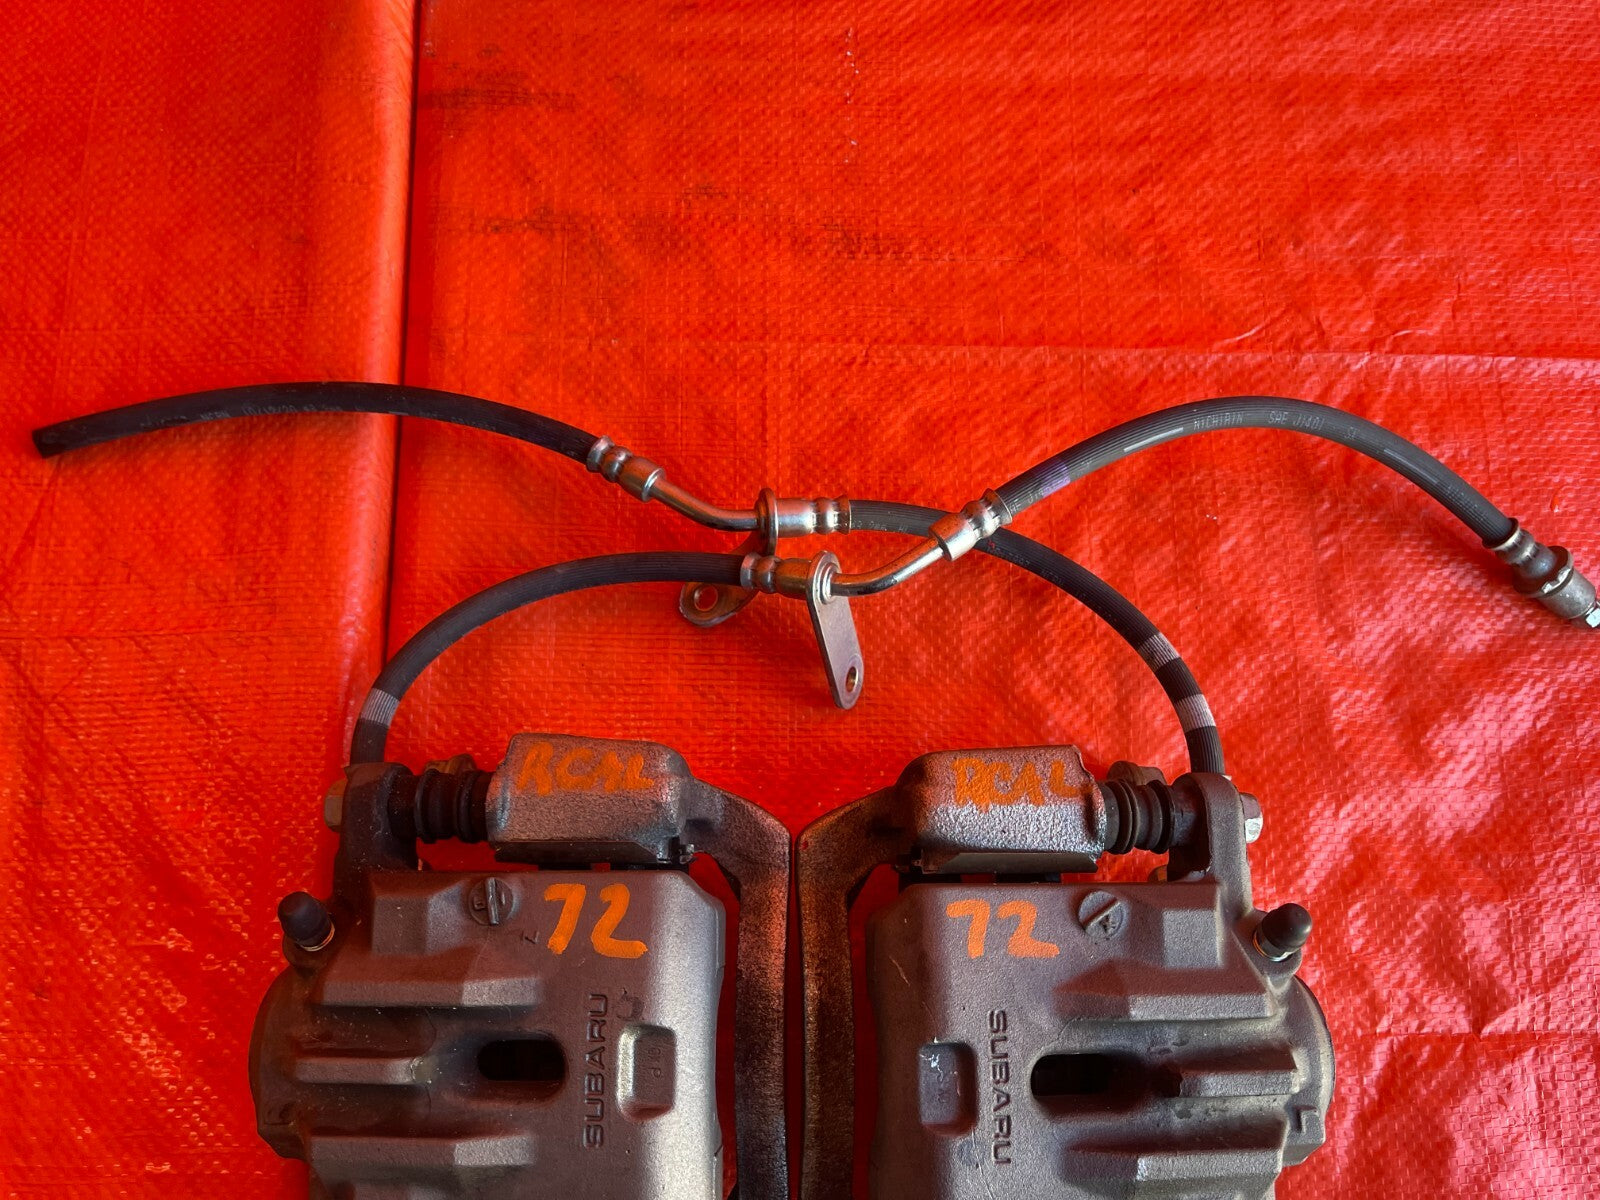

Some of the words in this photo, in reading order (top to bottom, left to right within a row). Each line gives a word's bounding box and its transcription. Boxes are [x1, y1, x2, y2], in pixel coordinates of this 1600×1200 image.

[1268, 411, 1289, 425] SAE
[544, 883, 649, 959] 72
[945, 898, 1061, 959] 72
[582, 993, 608, 1149] SUBARU
[987, 1009, 1012, 1165] SUBARU
